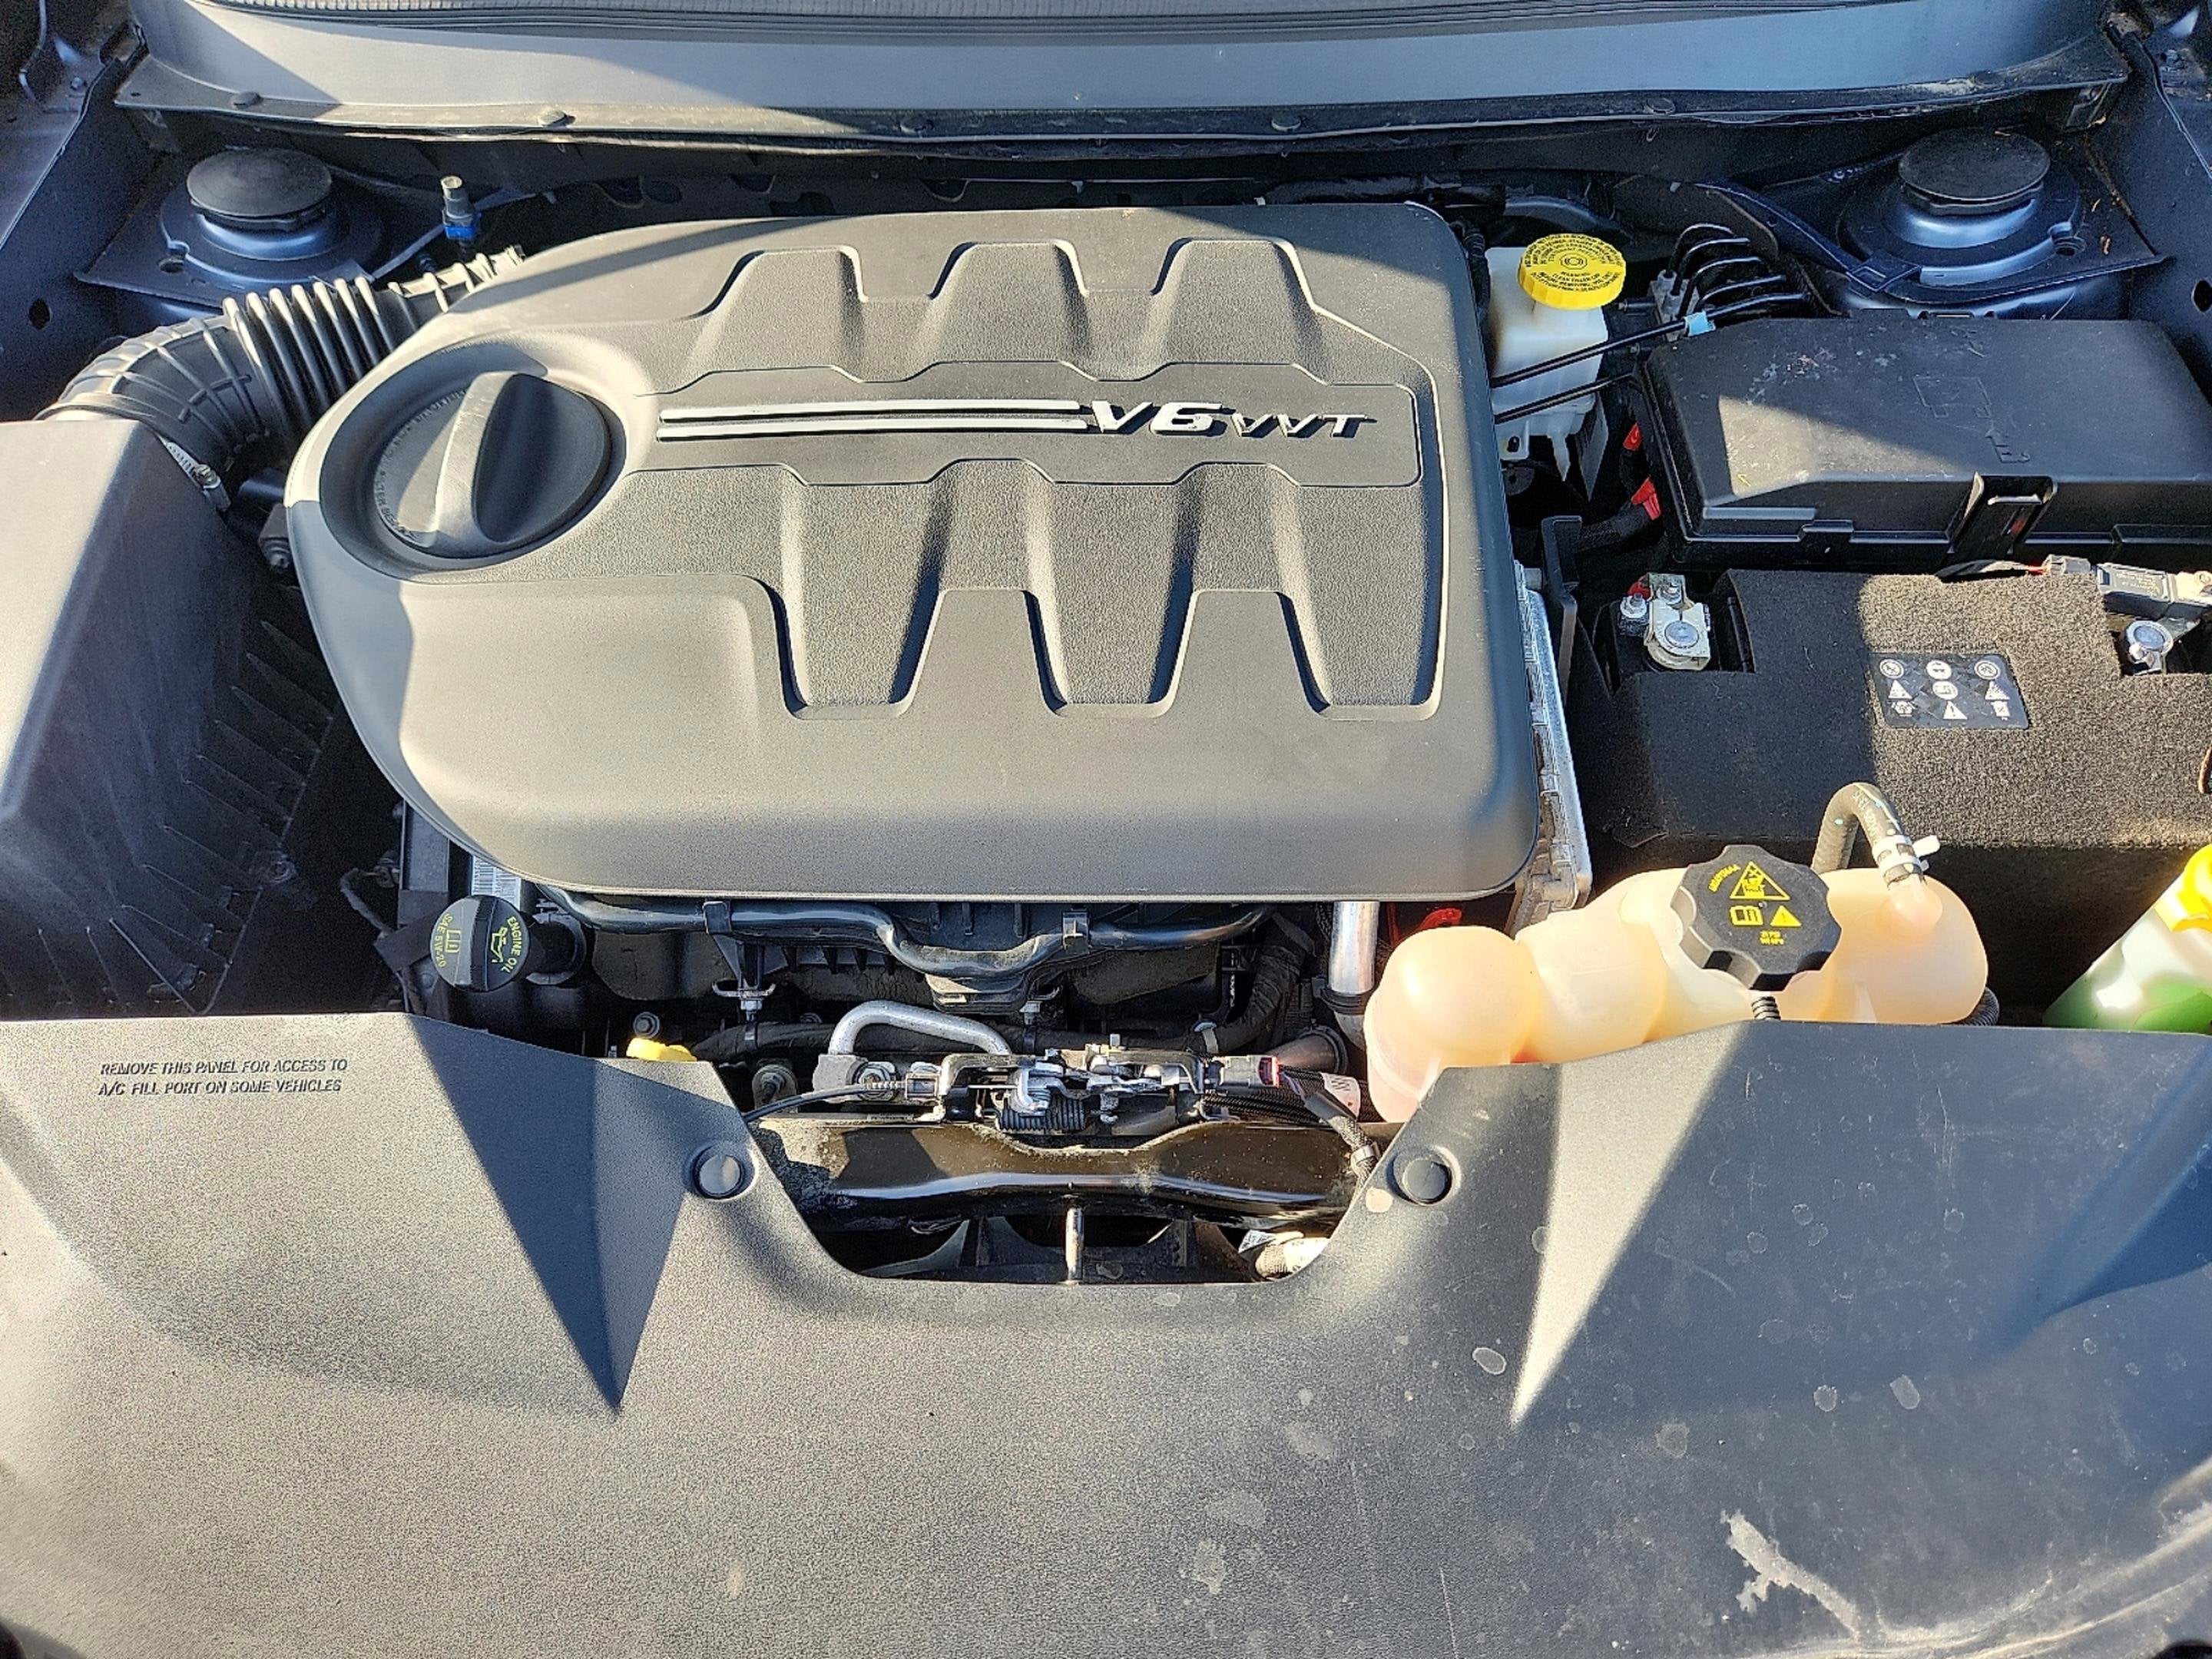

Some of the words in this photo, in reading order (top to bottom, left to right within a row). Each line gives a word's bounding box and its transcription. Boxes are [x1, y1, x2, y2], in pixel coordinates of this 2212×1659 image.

[1091, 400, 1224, 435] V6
[1230, 413, 1369, 437] VVT
[437, 913, 452, 933] SAE
[507, 916, 522, 956] ENGINE
[435, 935, 446, 968] 5W-20
[501, 957, 517, 972] OIL
[100, 1062, 158, 1075] REMOVE
[161, 1061, 192, 1075] THIS
[194, 1061, 238, 1074] PANEL
[241, 1060, 270, 1073] FOR
[272, 1059, 326, 1072] ACCESS
[330, 1058, 348, 1071] TO
[98, 1081, 126, 1096] A/C
[131, 1081, 159, 1095] FILL
[164, 1081, 202, 1094] PORT
[205, 1081, 227, 1094] ON
[230, 1080, 271, 1093] SOME
[276, 1079, 342, 1092] VEHICLES
